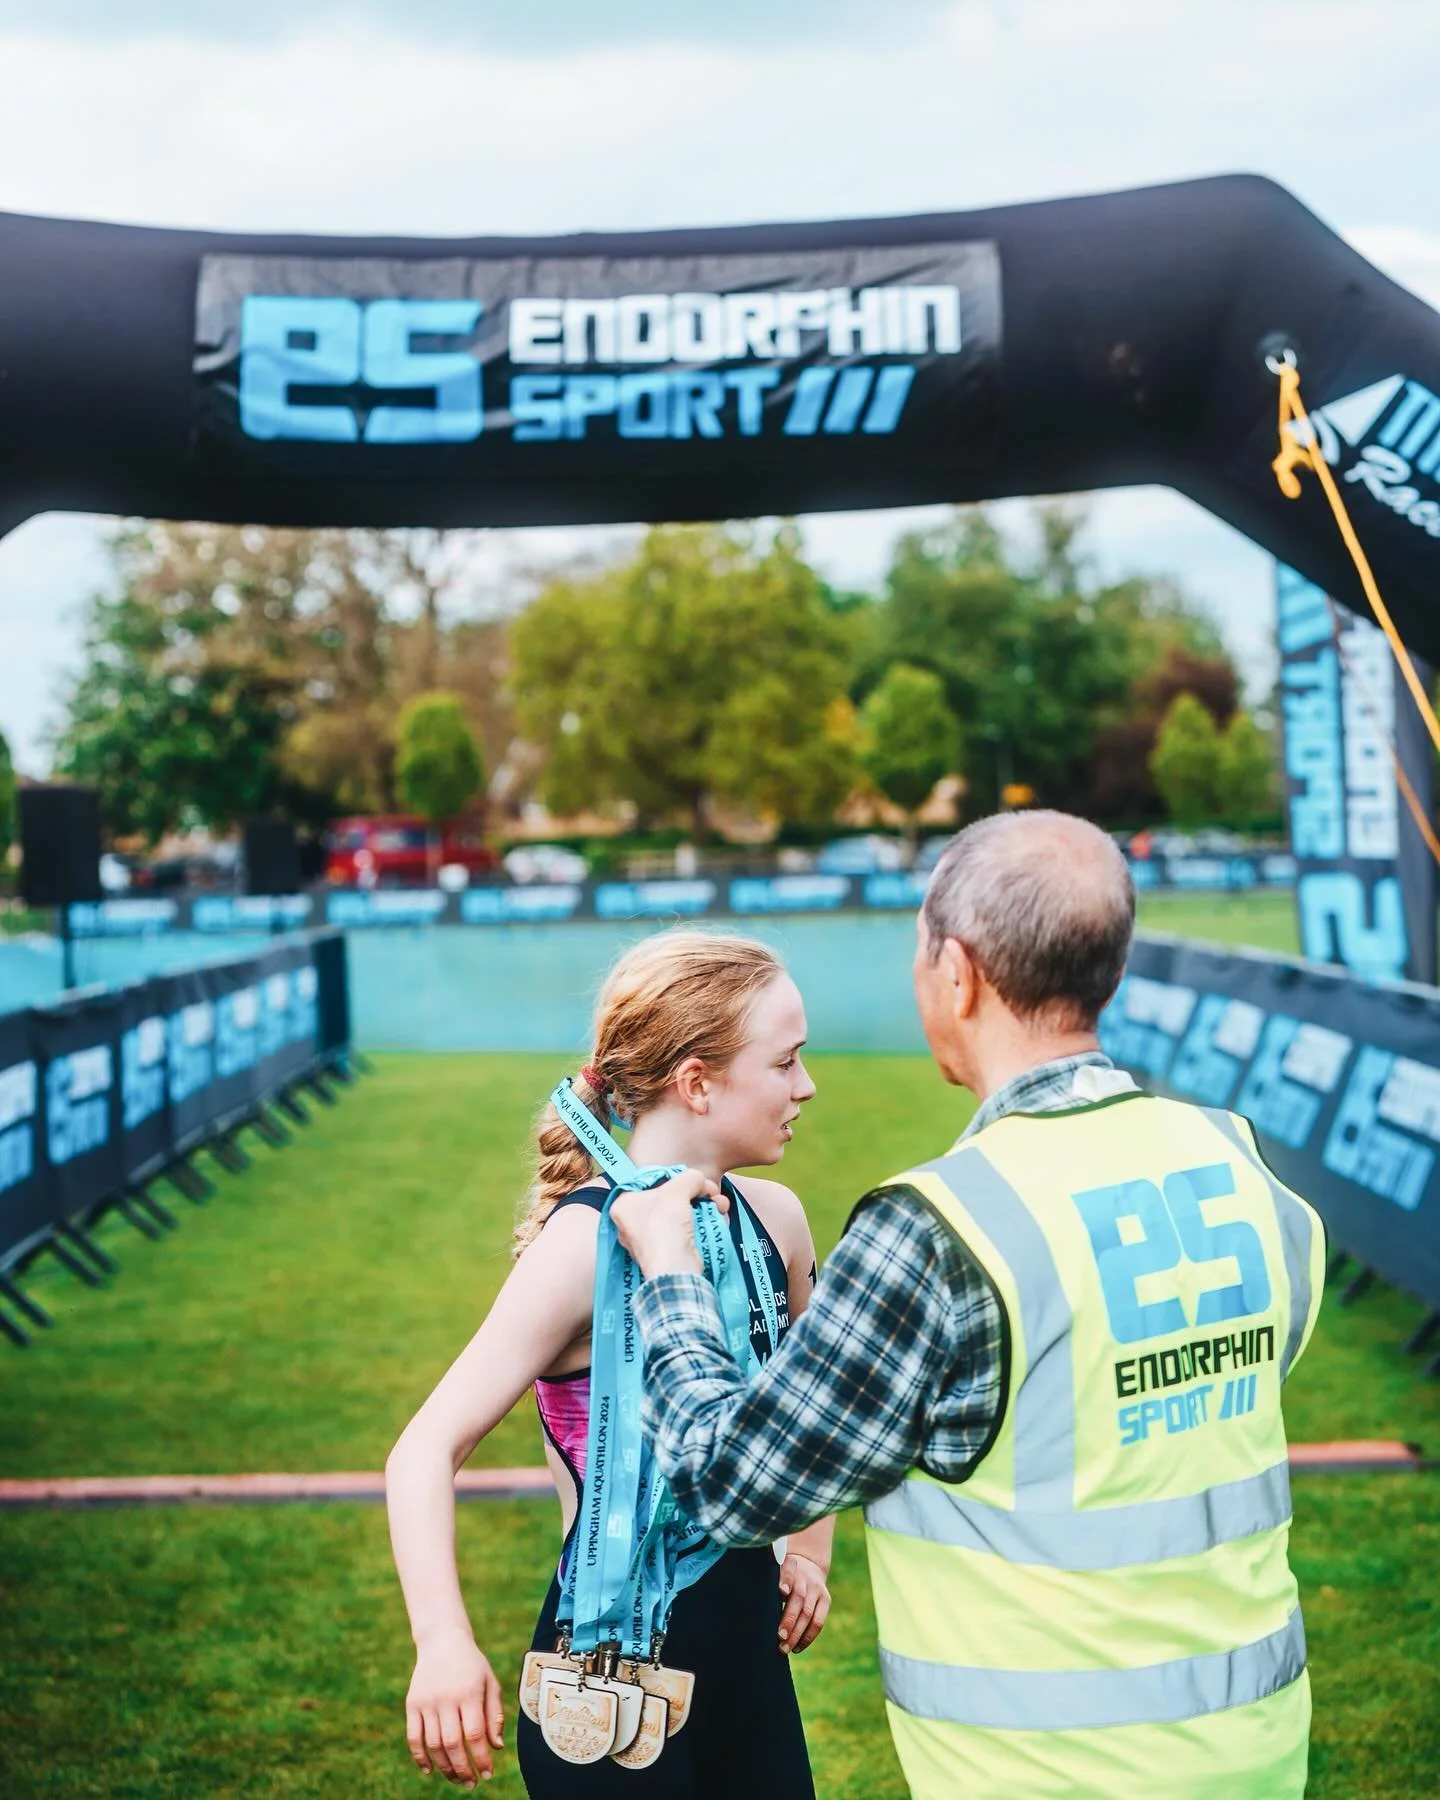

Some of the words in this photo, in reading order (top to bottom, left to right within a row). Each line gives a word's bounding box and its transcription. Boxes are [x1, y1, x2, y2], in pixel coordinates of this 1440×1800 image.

[509, 285, 961, 364] ENDORPHIN
[510, 367, 782, 441] SPORT
[597, 1143, 619, 1166] 2024
[623, 1293, 634, 1363] UPPINGHAM
[1114, 1325, 1274, 1398] ENDORPHIN
[600, 1395, 611, 1424] 2024
[1118, 1384, 1214, 1446] SPORT
[593, 1425, 608, 1495] AQUATHLON
[587, 1496, 602, 1567] UPPINGHAM
[632, 1596, 643, 1658] QUATHLON
